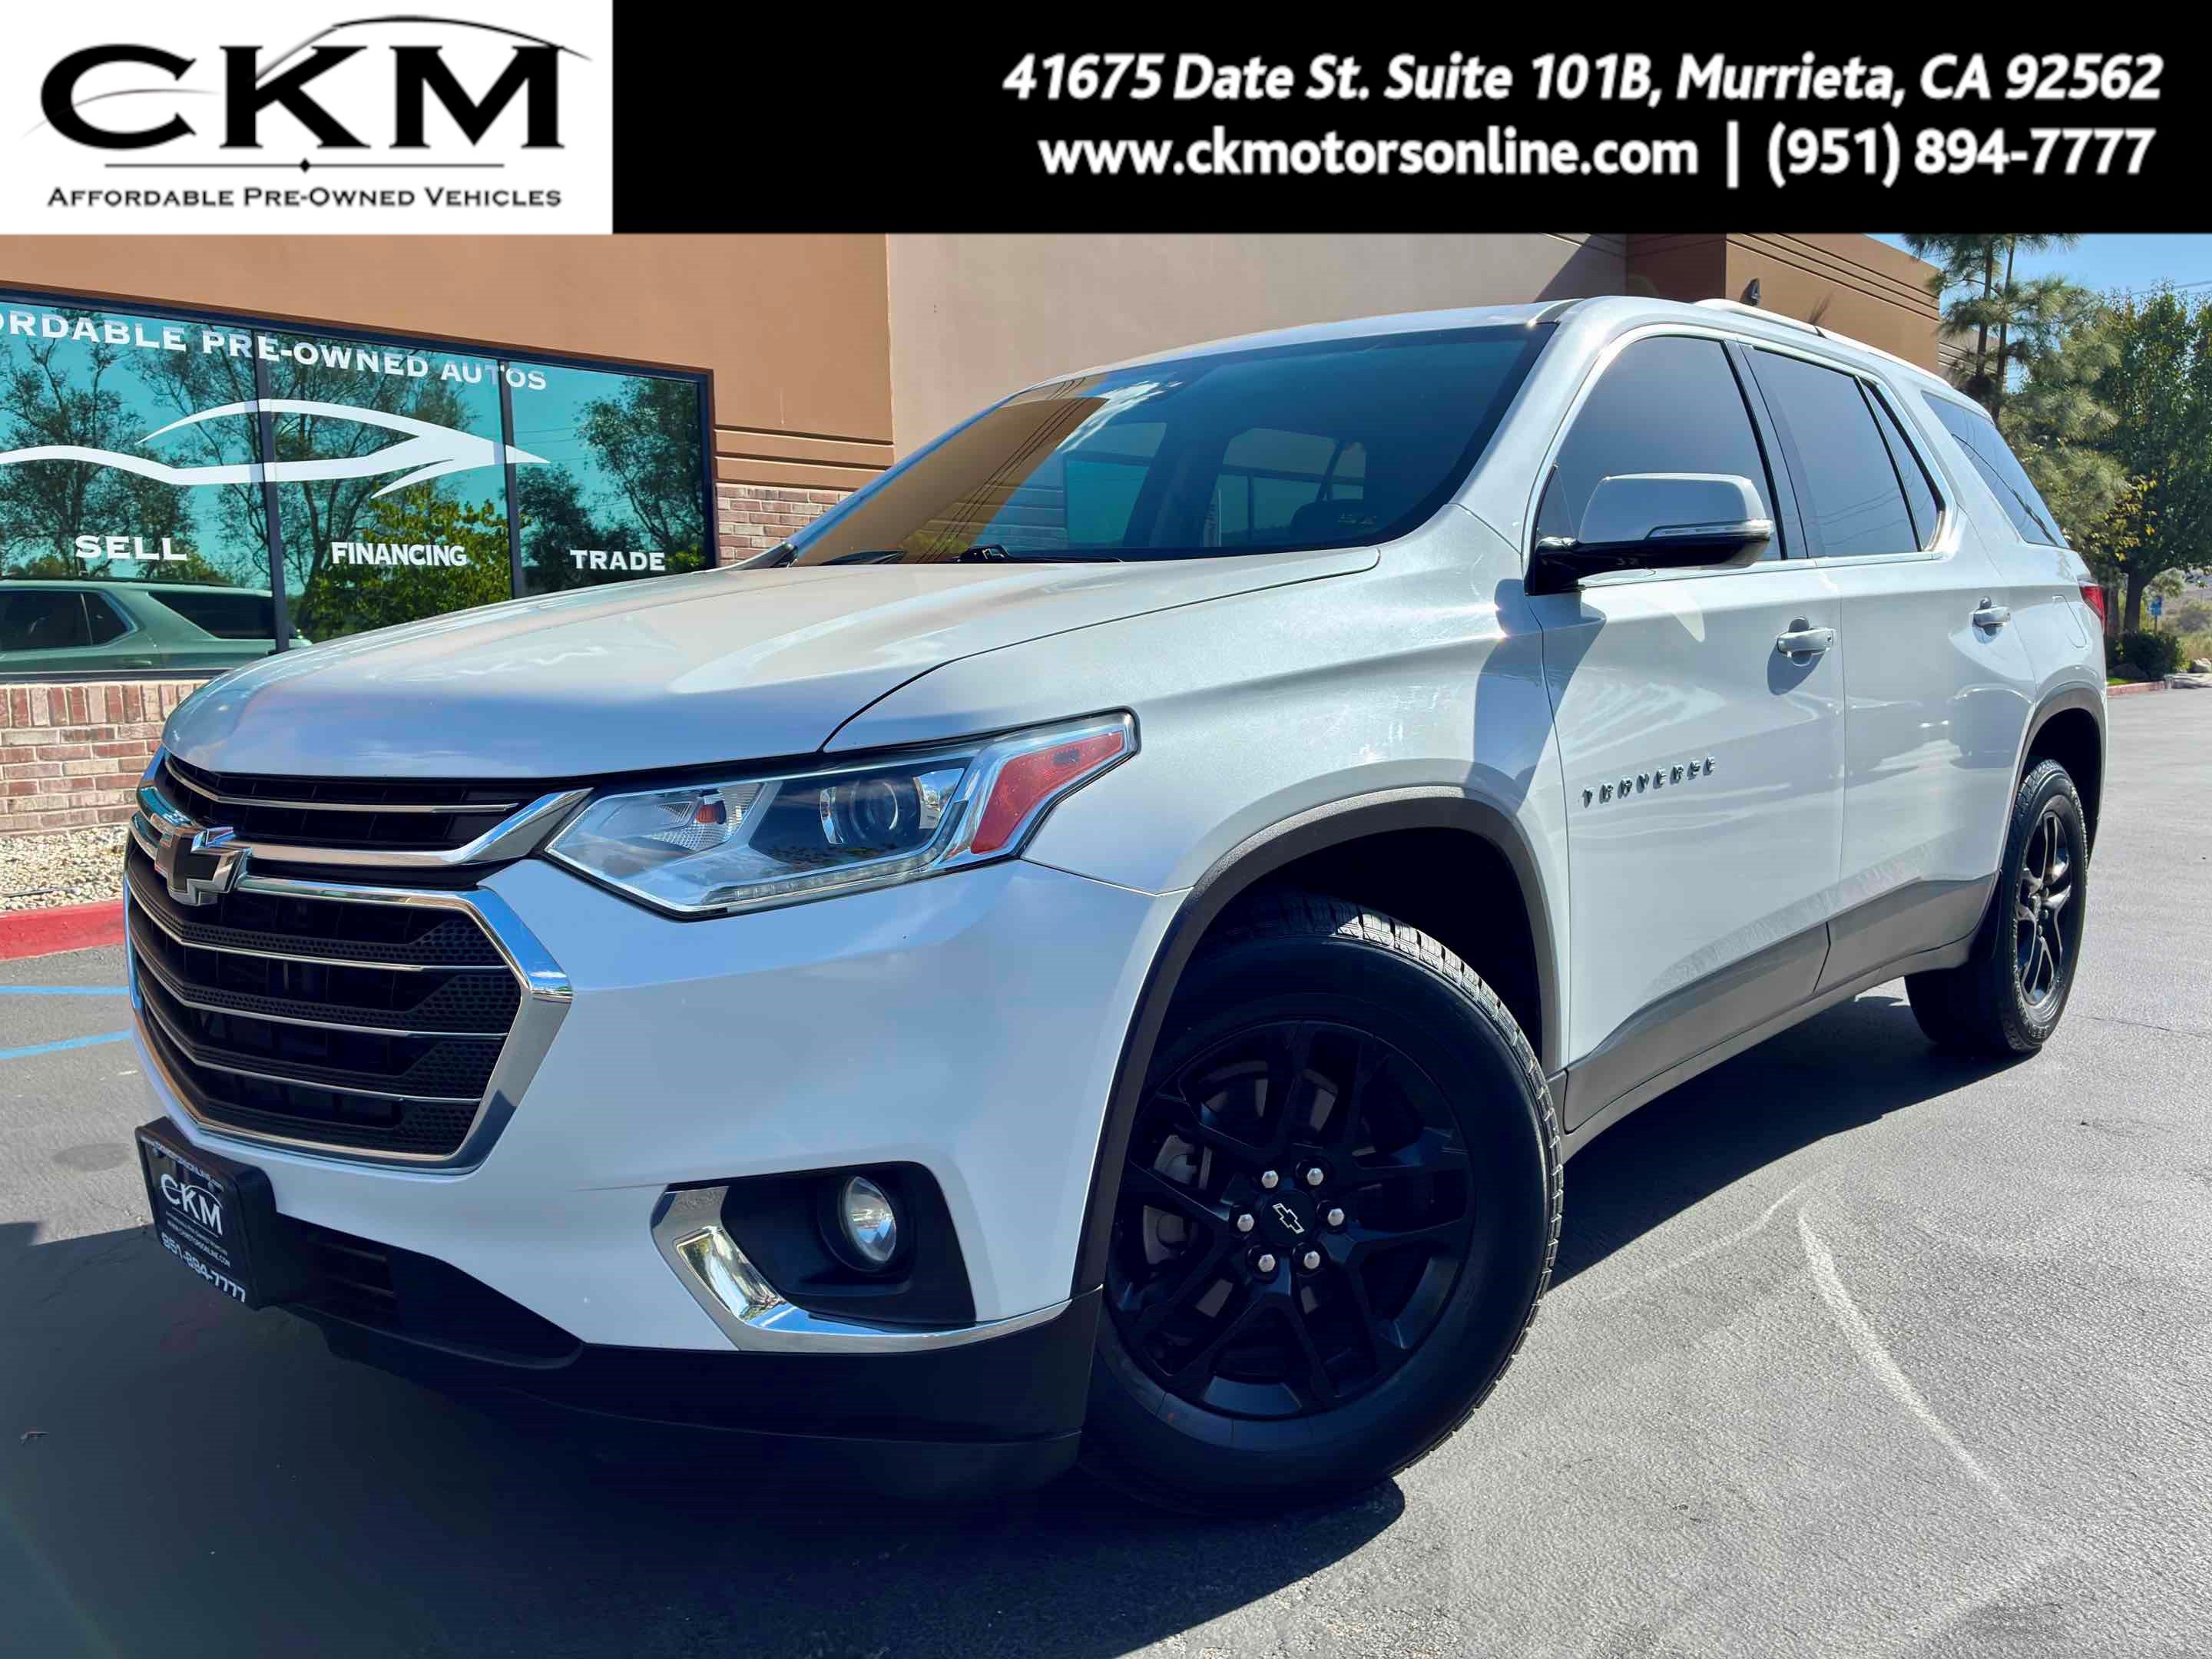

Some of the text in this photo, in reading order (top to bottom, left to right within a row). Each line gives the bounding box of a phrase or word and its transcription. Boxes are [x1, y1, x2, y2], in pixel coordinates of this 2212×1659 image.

[0, 309, 547, 391] RDABLE PRE-OWNED AUTOS
[75, 535, 187, 561] SELL
[331, 541, 468, 567] FINANCING
[570, 549, 666, 571] TRADE
[161, 1174, 224, 1236] CKM
